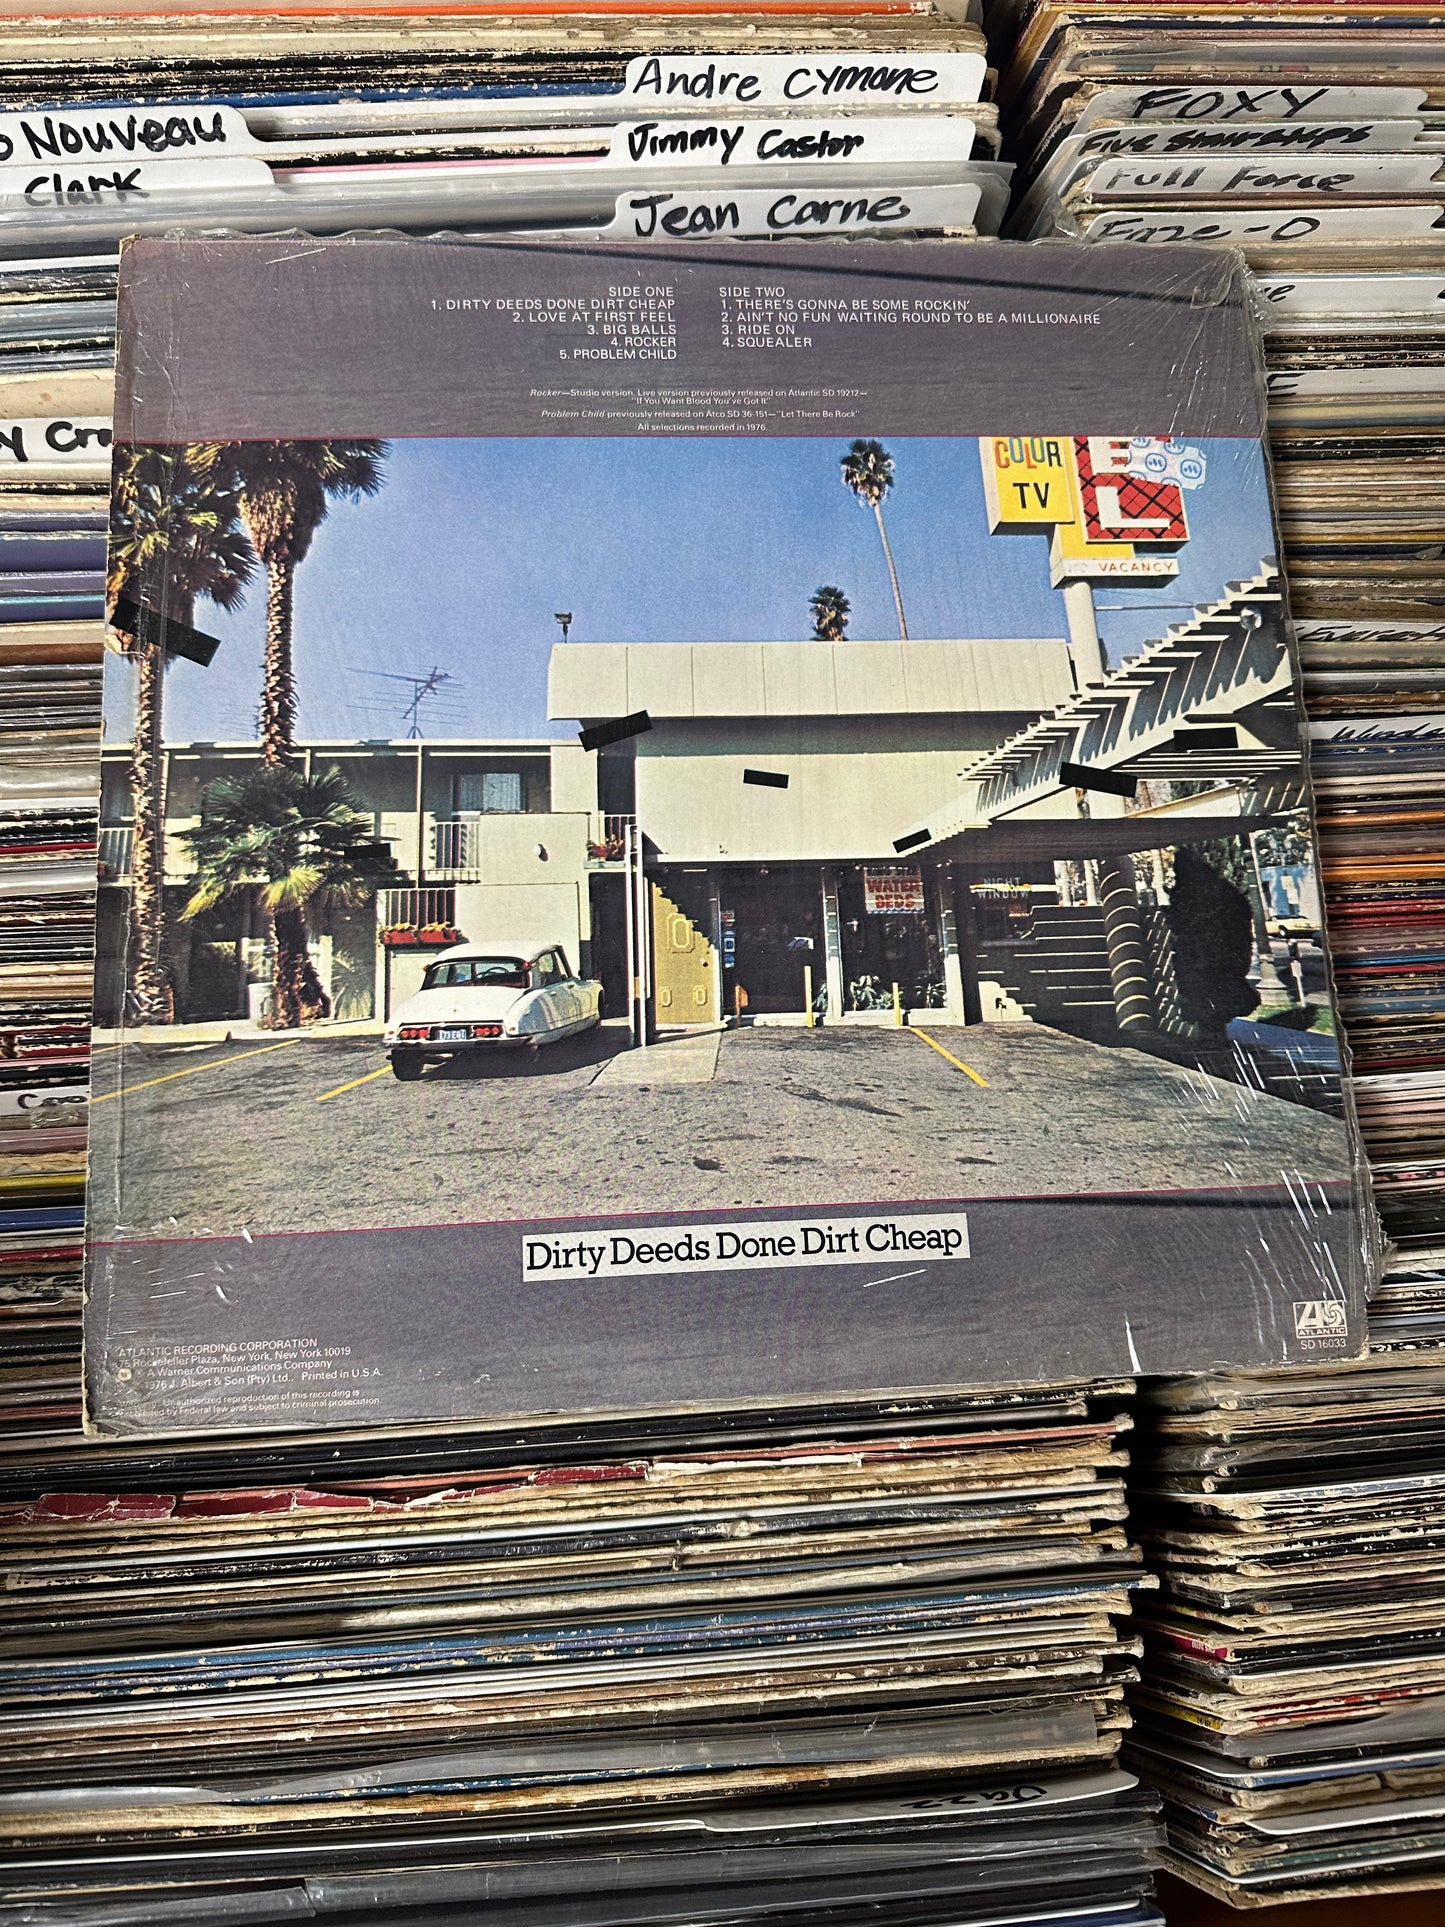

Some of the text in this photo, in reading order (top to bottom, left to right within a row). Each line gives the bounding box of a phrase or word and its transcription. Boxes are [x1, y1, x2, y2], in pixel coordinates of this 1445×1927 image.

[633, 58, 761, 101] Andre
[1132, 88, 1329, 118] FOXY
[628, 123, 744, 165] Jimmy
[1105, 165, 1354, 192] Full Force
[24, 168, 150, 206] Clark
[630, 193, 911, 237] Jean Carne
[608, 287, 674, 297] SIDE ONE
[719, 287, 785, 298] SIDE TWO
[431, 300, 676, 310] 1. DIRTY DEEDS DONE DIRT CHEAP
[721, 300, 970, 311] 1. THERE'S GONNA BE SOME ROCKIN'
[513, 312, 675, 323] 2. LOVE AT FIRST FEEL
[721, 312, 1101, 325] 2. AIN'T NO FUN WAITING ROUND TO BE A MILLIONAIRE
[587, 325, 677, 336] 3. BIG BALLS
[721, 324, 795, 335] 3. RIDE ON
[610, 337, 677, 347] 4. ROCKER
[722, 337, 812, 348] 4. SQUEALER
[559, 350, 677, 360] 5. PROBLEM CHILD
[637, 389, 656, 397] Live
[657, 389, 689, 397] version
[691, 389, 736, 397] previously
[737, 389, 773, 397] released
[775, 389, 786, 397] on
[787, 389, 821, 397] Atlantic
[822, 389, 835, 397] SD
[644, 397, 660, 405] You
[661, 397, 685, 405] Want
[686, 397, 712, 405] Blood
[743, 397, 759, 405] Got
[541, 410, 579, 418] Problem
[581, 410, 606, 418] Child
[607, 410, 652, 418] previously
[654, 410, 691, 418] released
[692, 410, 704, 418] on
[705, 410, 726, 418] Atco
[727, 410, 740, 418] SD
[795, 410, 821, 418] There
[822, 410, 834, 418] Be
[637, 423, 650, 431] All
[651, 423, 695, 431] selections
[696, 423, 735, 431] recorded
[736, 423, 745, 431] in
[995, 437, 1064, 469] COLOR
[1012, 482, 1050, 509] TV
[1099, 559, 1174, 573] VACANCY
[866, 879, 921, 893] WATER
[875, 894, 915, 909] BEDS
[526, 1223, 962, 1274] Dirty Deeds Done Dirt Cheap
[1298, 1328, 1346, 1336] ATLANTIC
[118, 1338, 318, 1358] ATLANTIC RECORDING CORPORATION
[1300, 1338, 1346, 1350] SD 16033
[190, 1354, 221, 1365] Plaza,
[222, 1353, 247, 1363] New
[248, 1352, 273, 1363] York,
[274, 1350, 298, 1360] New
[300, 1348, 322, 1358] York
[324, 1346, 351, 1356] 10019
[147, 1360, 333, 1377] A Warner Communications Company
[180, 1376, 212, 1387] Albert
[214, 1377, 222, 1386] &
[224, 1376, 245, 1385] Son
[247, 1374, 270, 1386] (Pty)
[301, 1370, 338, 1381] Printed
[339, 1369, 349, 1379] in
[223, 1393, 279, 1405] reproduction
[280, 1392, 290, 1400] of
[291, 1391, 308, 1399] this
[309, 1389, 352, 1399] recording
[352, 1389, 360, 1397] is
[178, 1405, 211, 1415] Federal
[213, 1404, 229, 1412] law
[230, 1403, 247, 1412] and
[248, 1401, 280, 1412] subject
[281, 1401, 290, 1409] to
[291, 1399, 327, 1409] criminal
